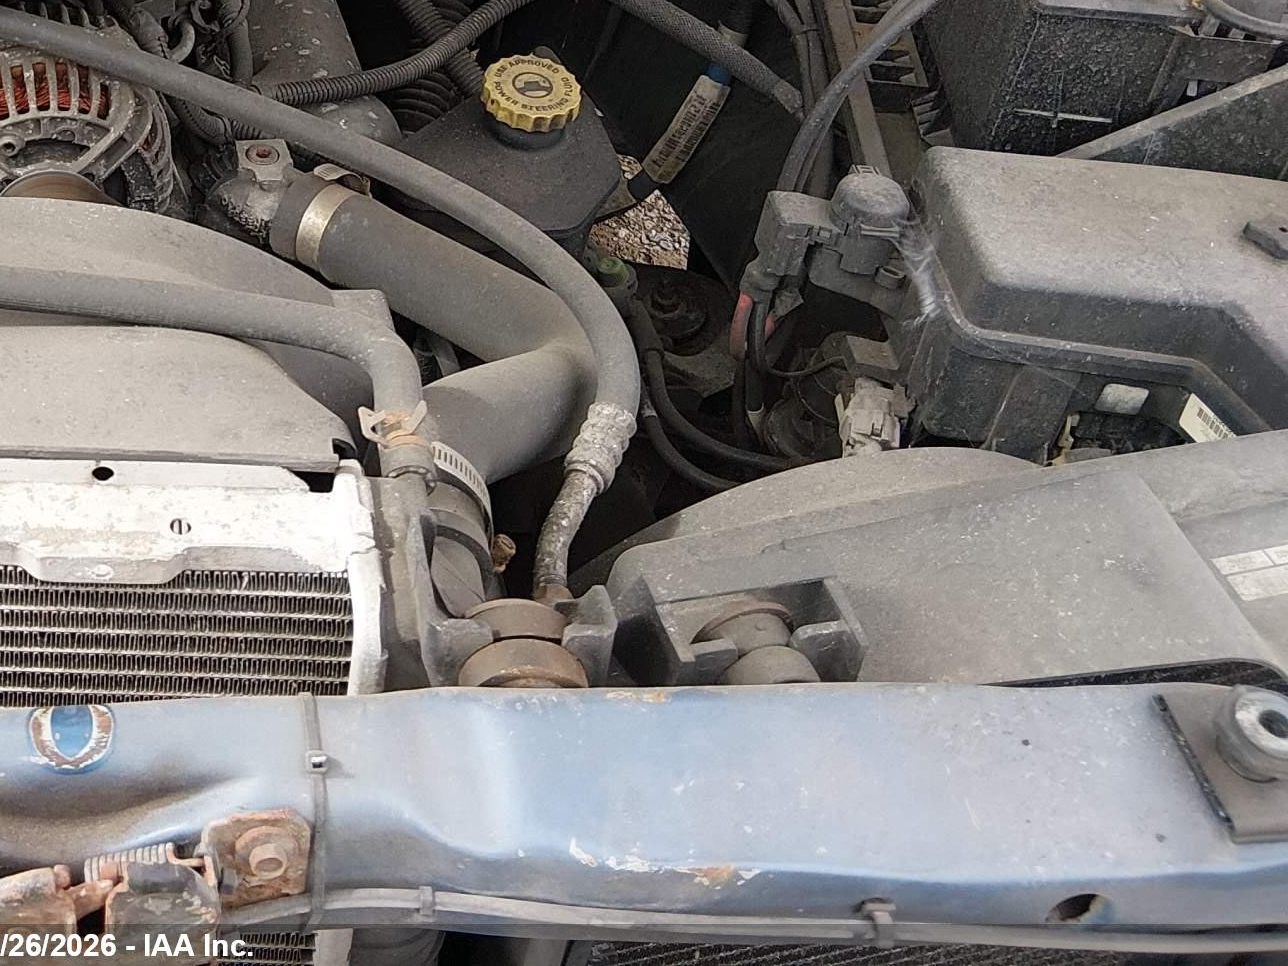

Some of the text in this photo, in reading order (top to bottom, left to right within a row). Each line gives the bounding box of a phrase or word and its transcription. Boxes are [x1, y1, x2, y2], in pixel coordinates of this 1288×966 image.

[494, 76, 574, 113] POWER STEERING FLUID
